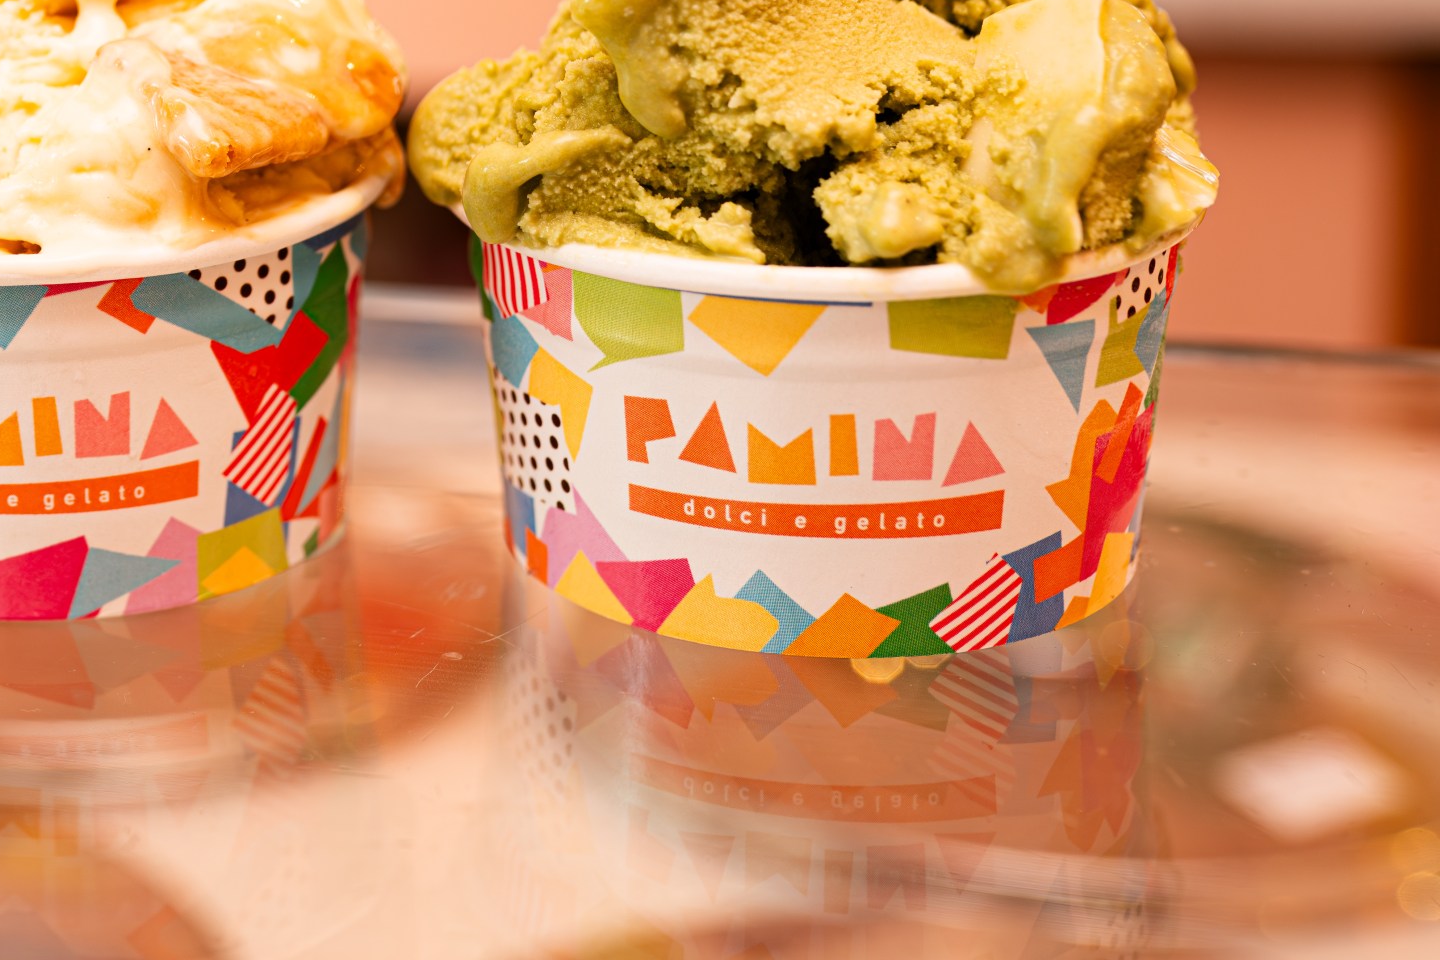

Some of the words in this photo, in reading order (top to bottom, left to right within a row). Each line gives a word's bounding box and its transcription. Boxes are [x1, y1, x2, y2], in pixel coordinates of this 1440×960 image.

[623, 394, 1007, 488] PAMINA
[6, 493, 19, 507] e
[42, 484, 146, 511] gelato
[683, 498, 768, 526] dolci
[794, 513, 808, 529] e
[834, 511, 946, 534] gelato
